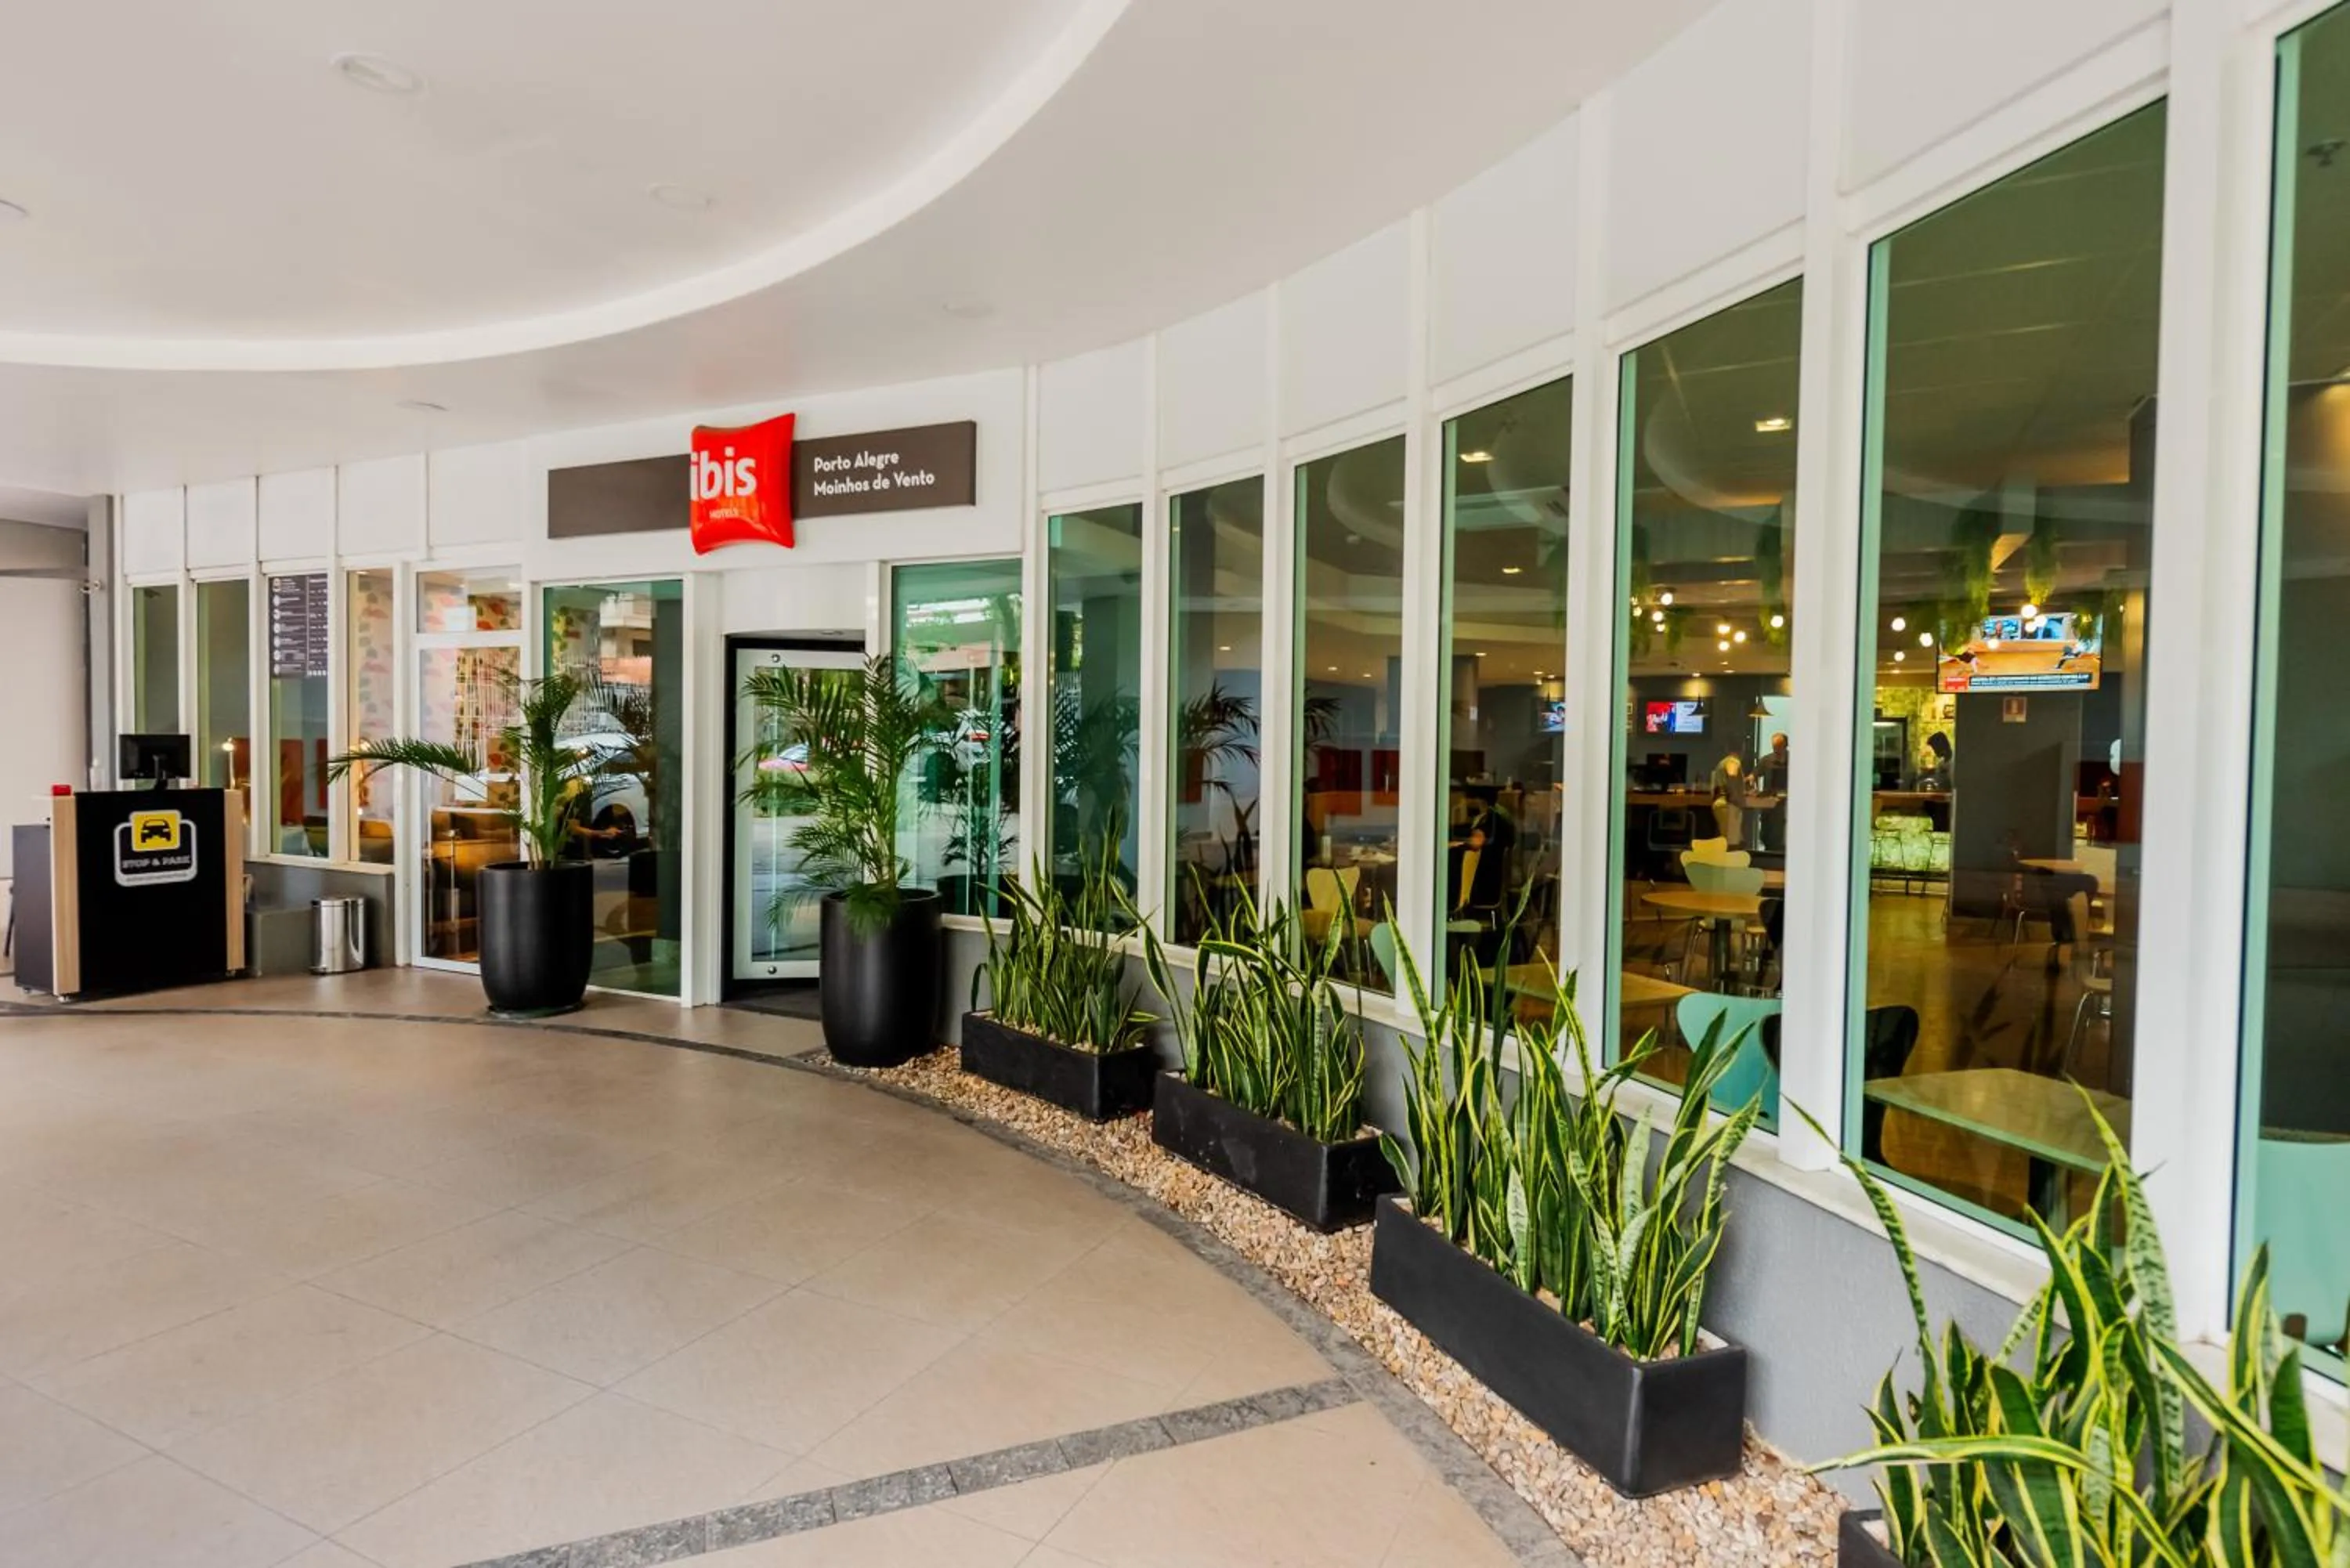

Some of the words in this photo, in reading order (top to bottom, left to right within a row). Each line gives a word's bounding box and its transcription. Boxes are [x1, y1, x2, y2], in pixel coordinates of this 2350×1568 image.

[690, 446, 757, 502] ibis
[814, 455, 852, 473] Porto
[854, 450, 900, 470] Alegre
[814, 475, 870, 496] Moinhos
[872, 472, 891, 490] de
[893, 469, 935, 487] Vento
[708, 508, 739, 520] HOTELS
